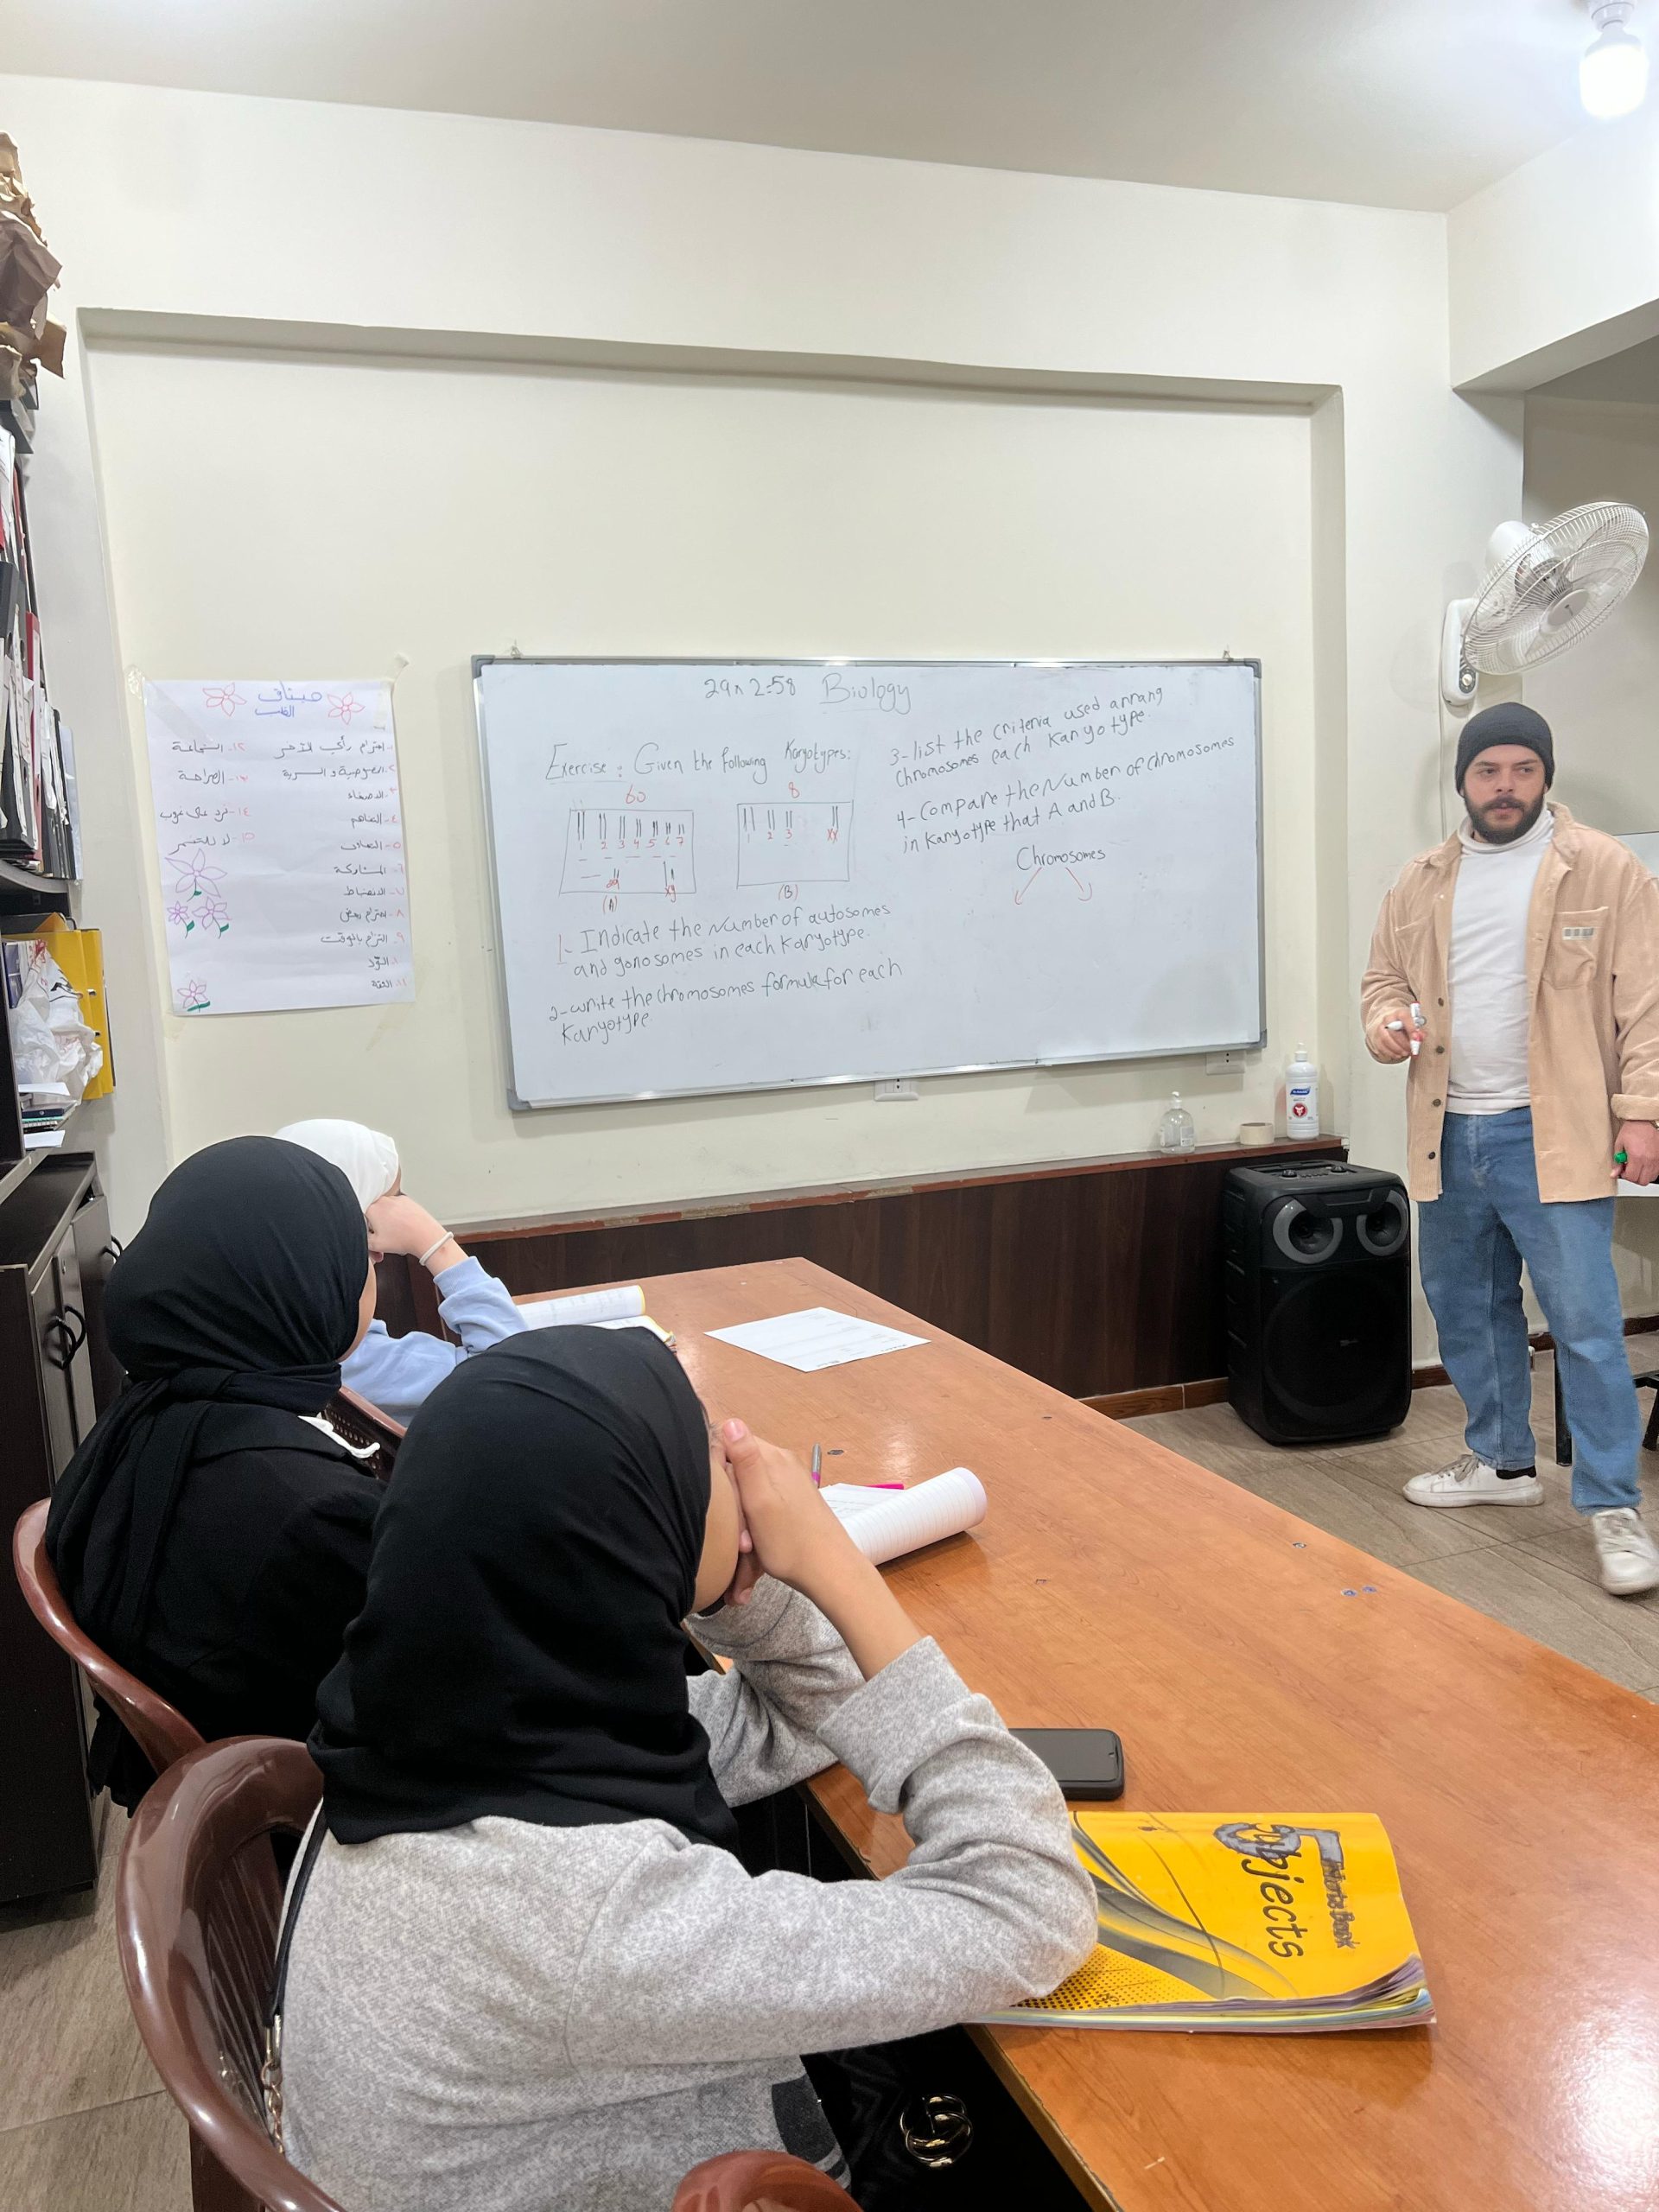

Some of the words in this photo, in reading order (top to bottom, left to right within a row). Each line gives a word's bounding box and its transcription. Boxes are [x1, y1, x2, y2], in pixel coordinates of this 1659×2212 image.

[820, 672, 911, 715] Biology
[954, 728, 982, 750] the
[1065, 696, 1100, 720] used
[634, 742, 683, 775] Given
[694, 749, 712, 772] the
[992, 735, 1030, 765] each
[625, 784, 646, 804] 60
[788, 781, 800, 799] 8
[1005, 779, 1039, 807] the
[1126, 757, 1145, 779] of
[766, 831, 773, 841] 2
[785, 830, 793, 840] 3
[903, 836, 919, 854] in
[1002, 806, 1040, 832] that
[1048, 802, 1063, 820] A
[1067, 793, 1096, 813] and
[601, 842, 607, 850] 2
[618, 840, 625, 849] 3
[633, 839, 640, 849] 4
[646, 838, 656, 849] 5
[676, 836, 683, 847] 7
[778, 883, 798, 900] (B)
[580, 919, 659, 954] Indicate
[669, 916, 702, 942] the
[781, 906, 803, 926] of
[809, 904, 892, 925] autosomes
[574, 959, 607, 978] and
[613, 947, 703, 977] gonosomes
[714, 944, 729, 960] in
[734, 934, 776, 957] each
[621, 986, 652, 1010] the
[820, 967, 854, 990] for
[859, 957, 903, 983] each
